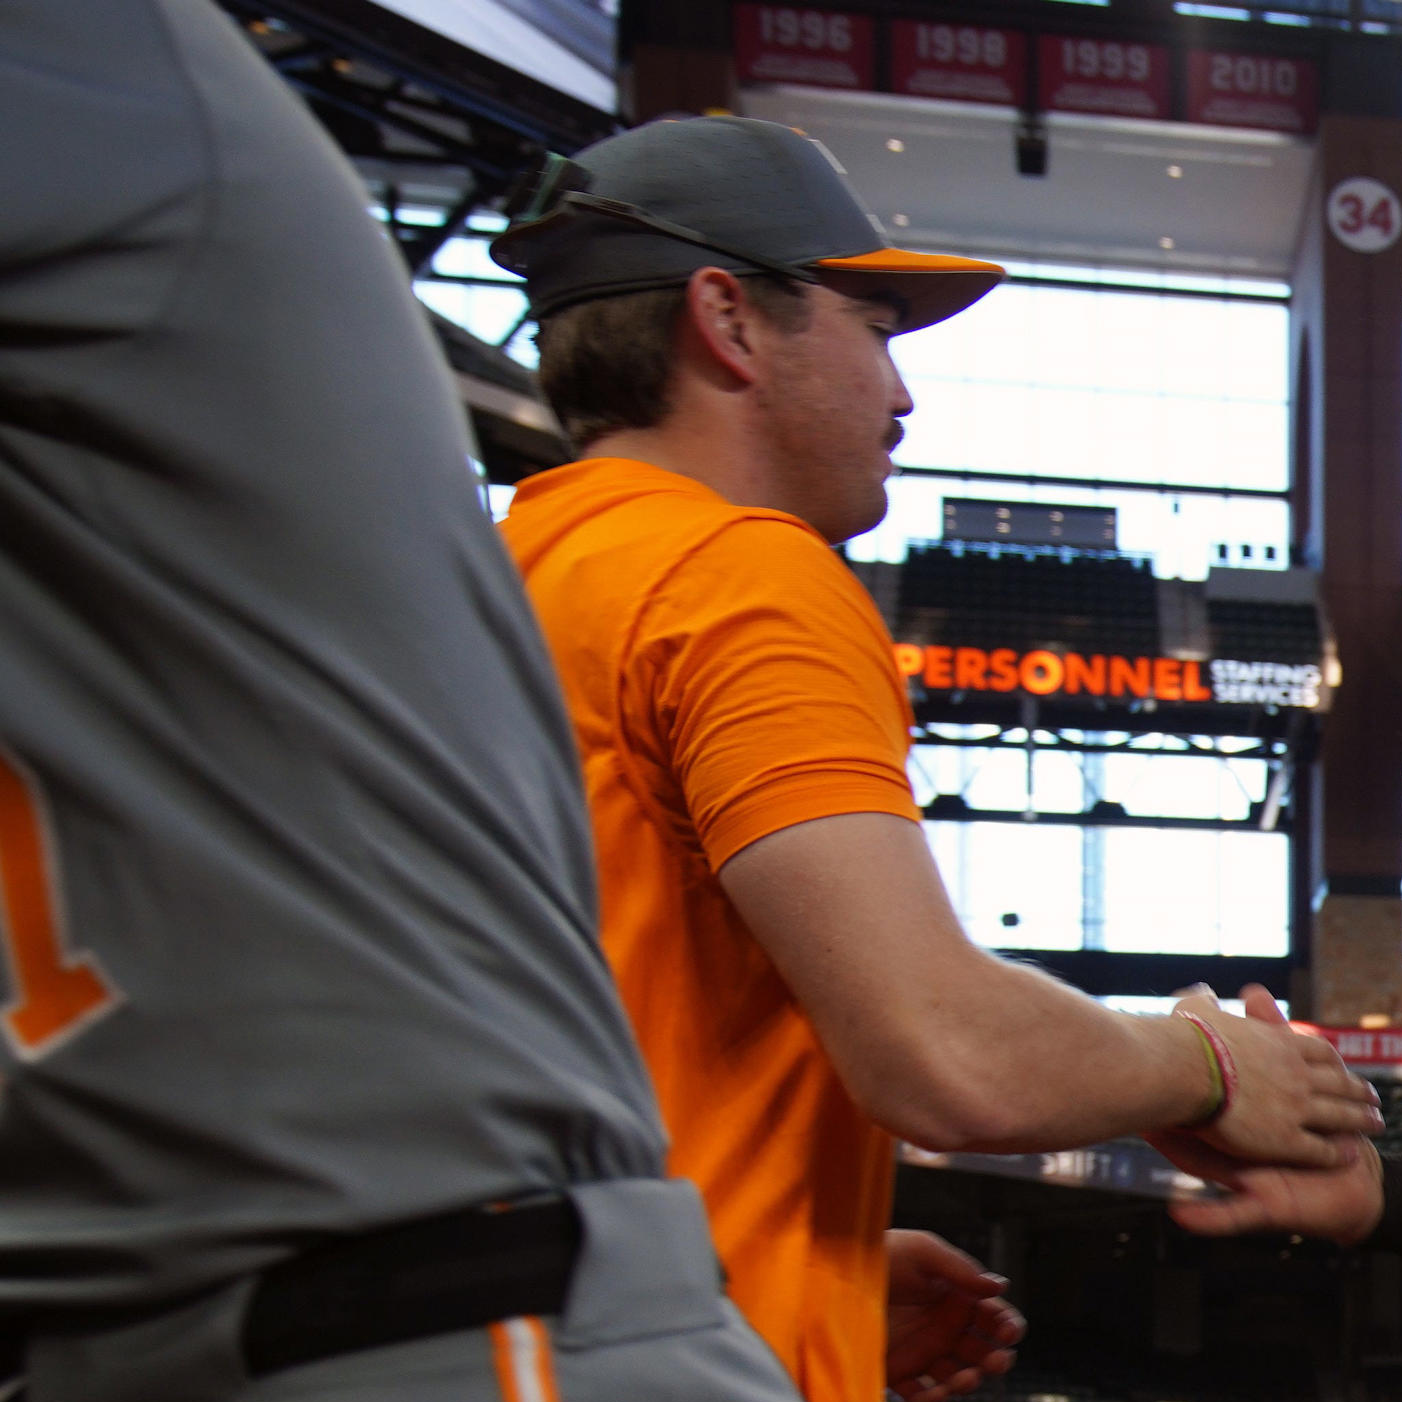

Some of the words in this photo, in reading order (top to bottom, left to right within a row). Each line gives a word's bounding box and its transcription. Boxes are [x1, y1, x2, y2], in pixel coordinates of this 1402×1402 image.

[759, 7, 852, 51] 1996
[914, 23, 1007, 68] 1998
[1062, 38, 1150, 82] 1999
[1210, 53, 1298, 96] 2010
[1339, 193, 1393, 237] 34
[893, 643, 1212, 701] PERSONNEL
